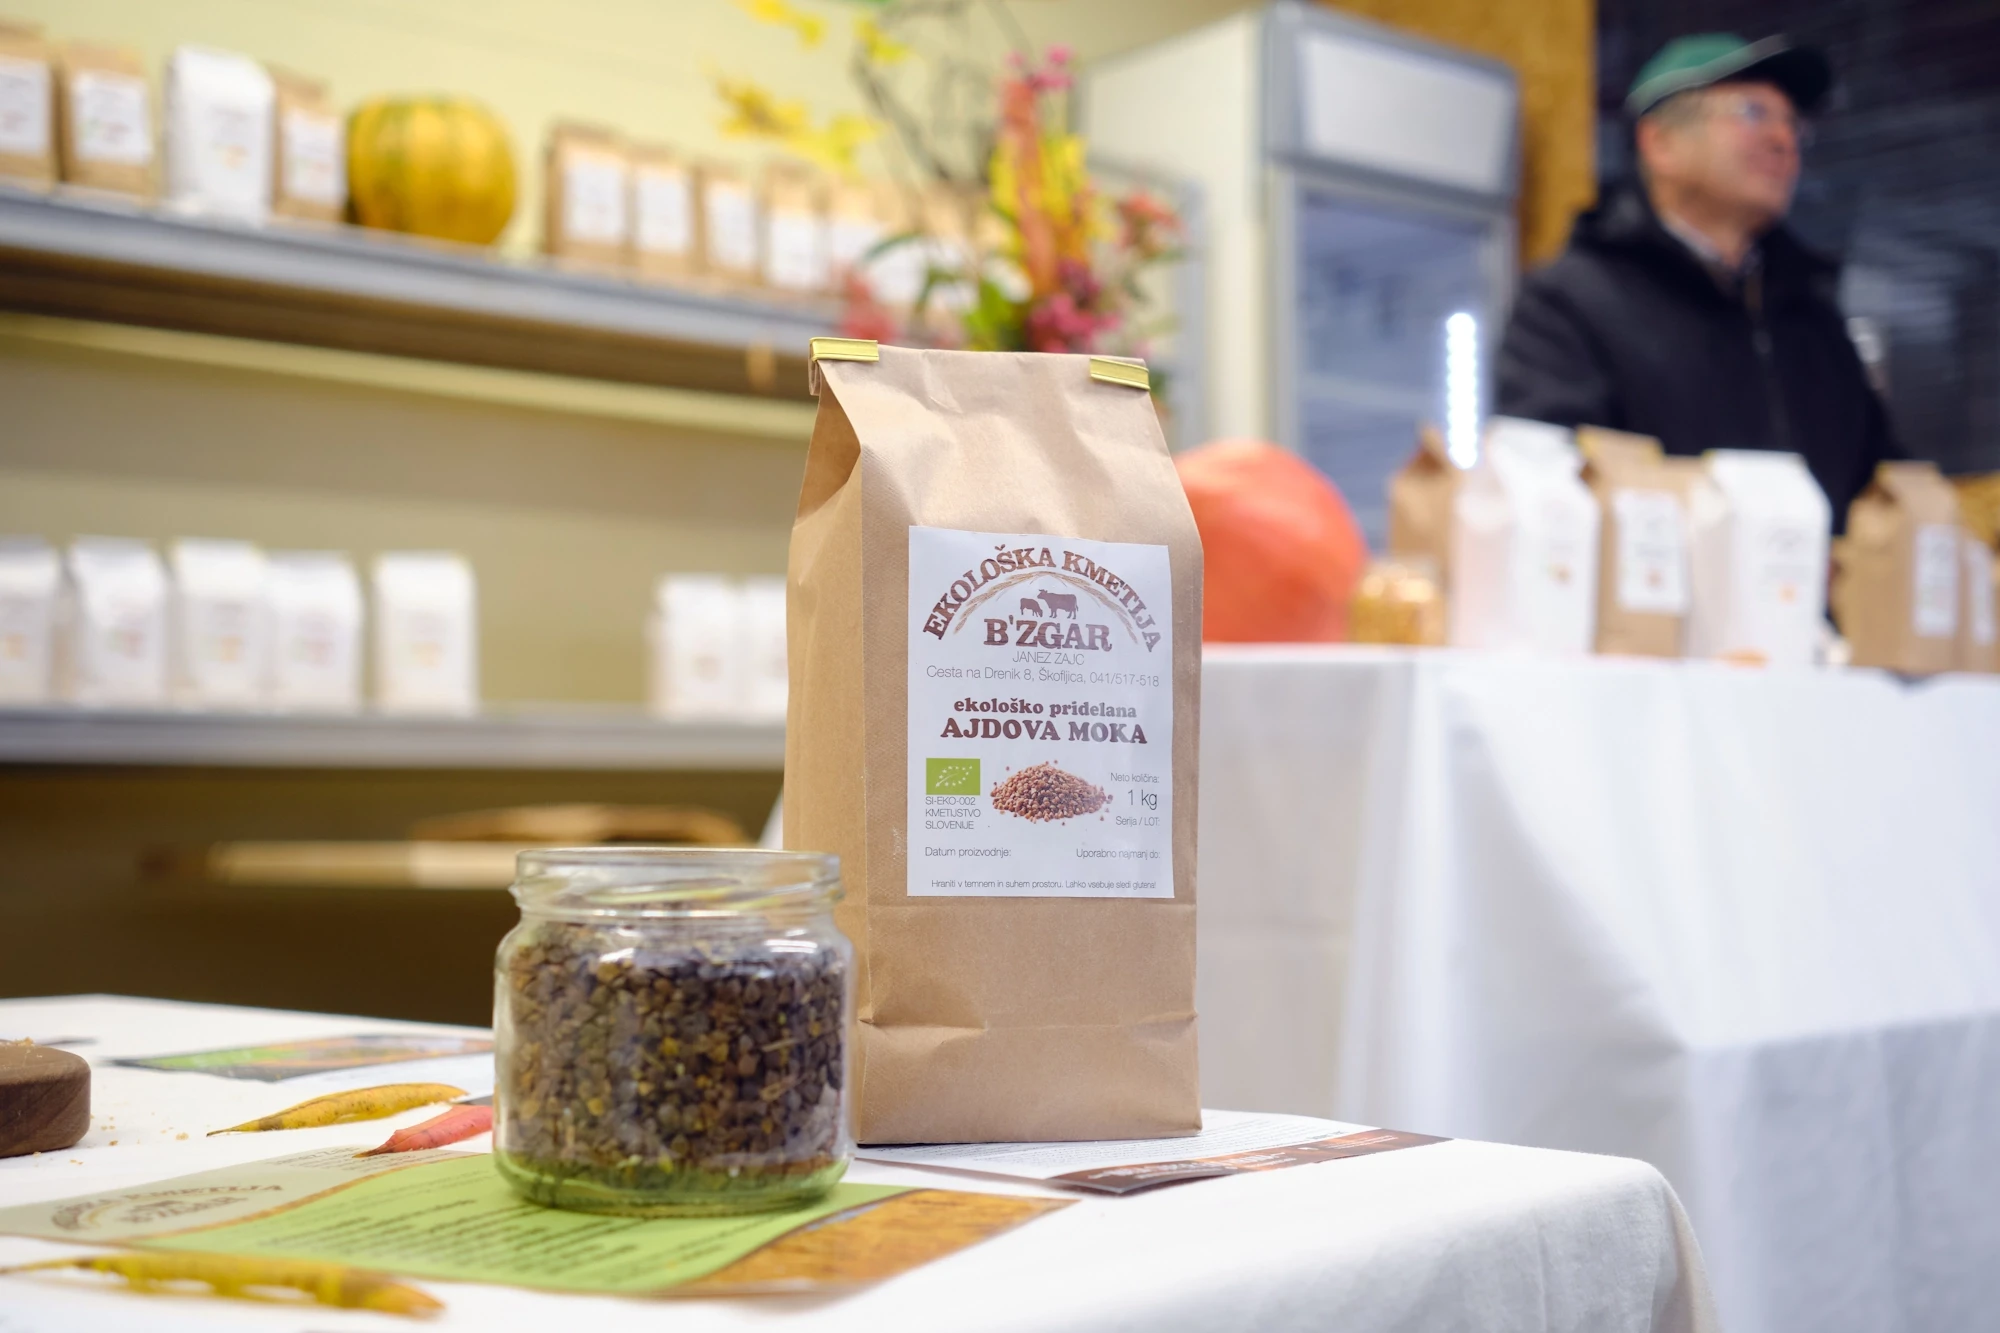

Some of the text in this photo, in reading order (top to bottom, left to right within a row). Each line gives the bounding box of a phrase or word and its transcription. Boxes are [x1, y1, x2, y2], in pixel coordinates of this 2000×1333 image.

[922, 544, 1161, 652] EKOLOŠKA KMETIJA
[983, 615, 1112, 652] B'ZGAR
[1012, 651, 1085, 665] JANEZ ZAJC
[926, 665, 1160, 687] Cesta na Drenik 8, Škofljica, 041/517-518
[954, 697, 1137, 718] ekološko pridelana
[940, 718, 1148, 744] AJDOVA MOKA
[1110, 772, 1160, 784] Neto količina:
[925, 796, 976, 806] SI-EKO-002
[1128, 789, 1158, 811] 1 kg
[925, 808, 982, 818] KMETIJSTVO
[925, 820, 975, 830] SLOVENIJE
[1115, 815, 1138, 827] Serija
[1144, 816, 1160, 827] LOT:
[925, 846, 1012, 859] Datum proizvodnje:
[1076, 848, 1161, 861] Uporabno najmanj do:
[931, 879, 956, 888] Hraniti
[964, 880, 996, 888] temnem
[997, 880, 1004, 888] in
[1005, 880, 1031, 888] suhem
[1031, 881, 1064, 890] prostoru.
[1065, 880, 1087, 889] Lahko
[1087, 881, 1115, 890] vsebuje
[1115, 881, 1131, 889] sledi
